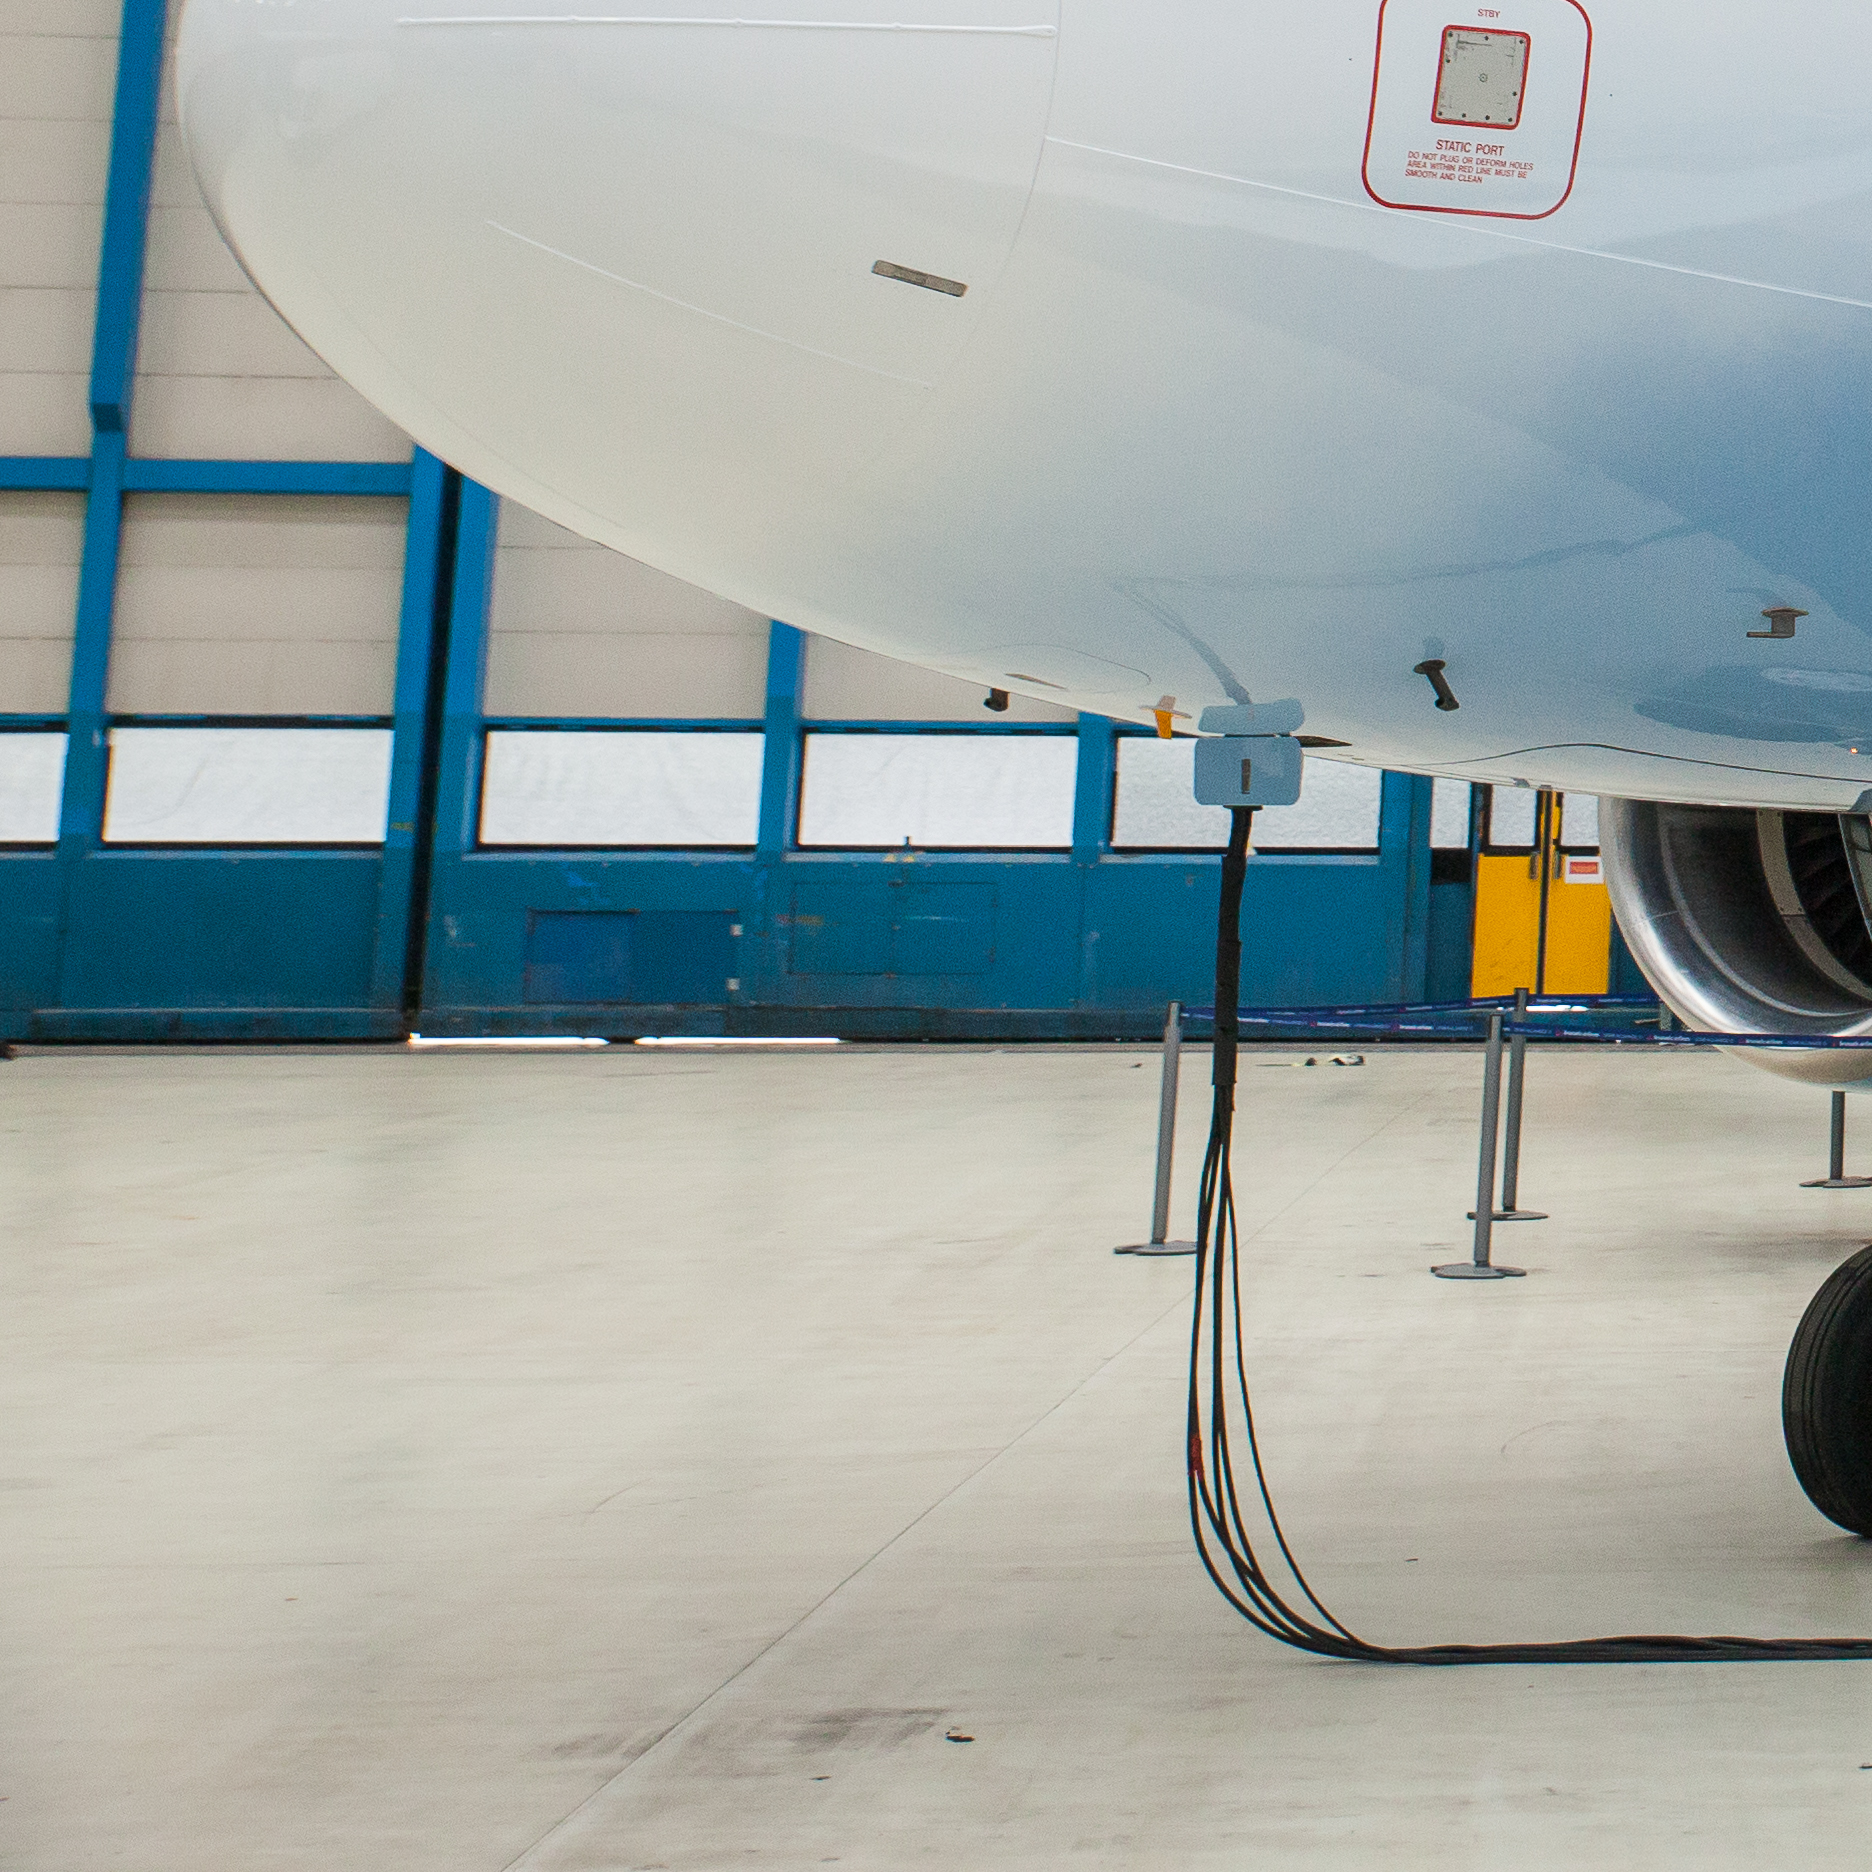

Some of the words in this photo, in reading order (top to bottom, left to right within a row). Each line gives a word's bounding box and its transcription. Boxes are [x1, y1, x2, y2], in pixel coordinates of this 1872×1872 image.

[1477, 8, 1501, 19] STBY
[1435, 139, 1472, 153] STATIC
[1475, 143, 1505, 156] PORT
[1407, 150, 1420, 159] DO
[1421, 152, 1438, 161] NOT
[1440, 154, 1460, 163] PLUG
[1461, 156, 1473, 165] OR
[1475, 157, 1507, 168] DEFORM
[1509, 160, 1534, 171] HOLES
[1405, 169, 1437, 179] SMOOTH
[1439, 172, 1456, 181] AND
[1458, 174, 1483, 184] CLEAN
[1407, 160, 1427, 169] AREA
[1430, 162, 1456, 172] WITHIN
[1458, 164, 1474, 173] RED
[1475, 167, 1492, 176] LINE
[1494, 169, 1515, 178] MUST
[1517, 170, 1528, 179] BE
